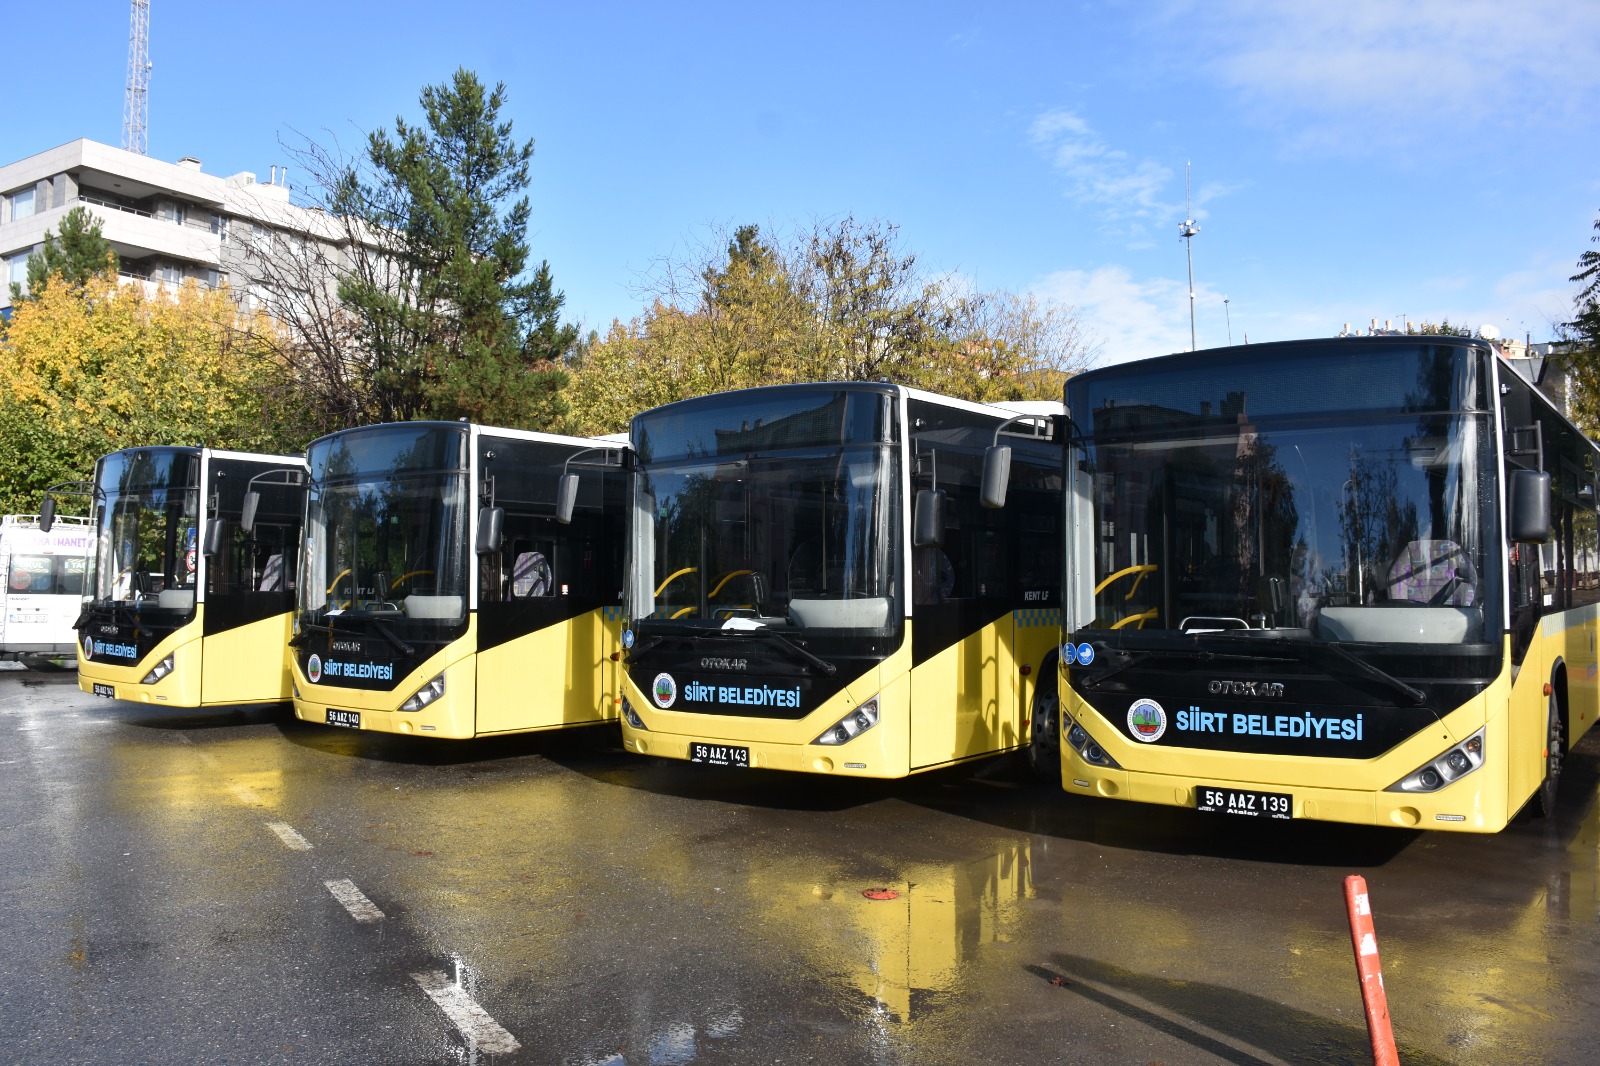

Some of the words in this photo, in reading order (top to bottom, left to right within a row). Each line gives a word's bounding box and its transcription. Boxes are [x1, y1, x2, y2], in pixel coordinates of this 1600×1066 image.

[1024, 591, 1041, 600] KENT
[1041, 591, 1049, 600] LF
[105, 642, 137, 658] BELEDİYESİ
[323, 659, 342, 676] SİİRT
[343, 661, 393, 680] BELEDİYESİ
[700, 657, 748, 670] OTOKAR
[684, 680, 716, 703] SİİRT
[718, 684, 800, 708] BELEDİYESİ
[1208, 680, 1285, 697] OTOKAR
[329, 711, 336, 721] 56
[348, 713, 359, 724] 140
[1176, 705, 1228, 733] SİİRT
[1232, 711, 1363, 741] BELEDİYESİ
[696, 745, 708, 758] 56
[709, 746, 727, 760] AAZ
[729, 748, 747, 762] 143
[1205, 790, 1224, 806] 56
[1228, 793, 1256, 810] AAZ
[1260, 795, 1288, 812] 139
[1226, 808, 1259, 816] Atalay
